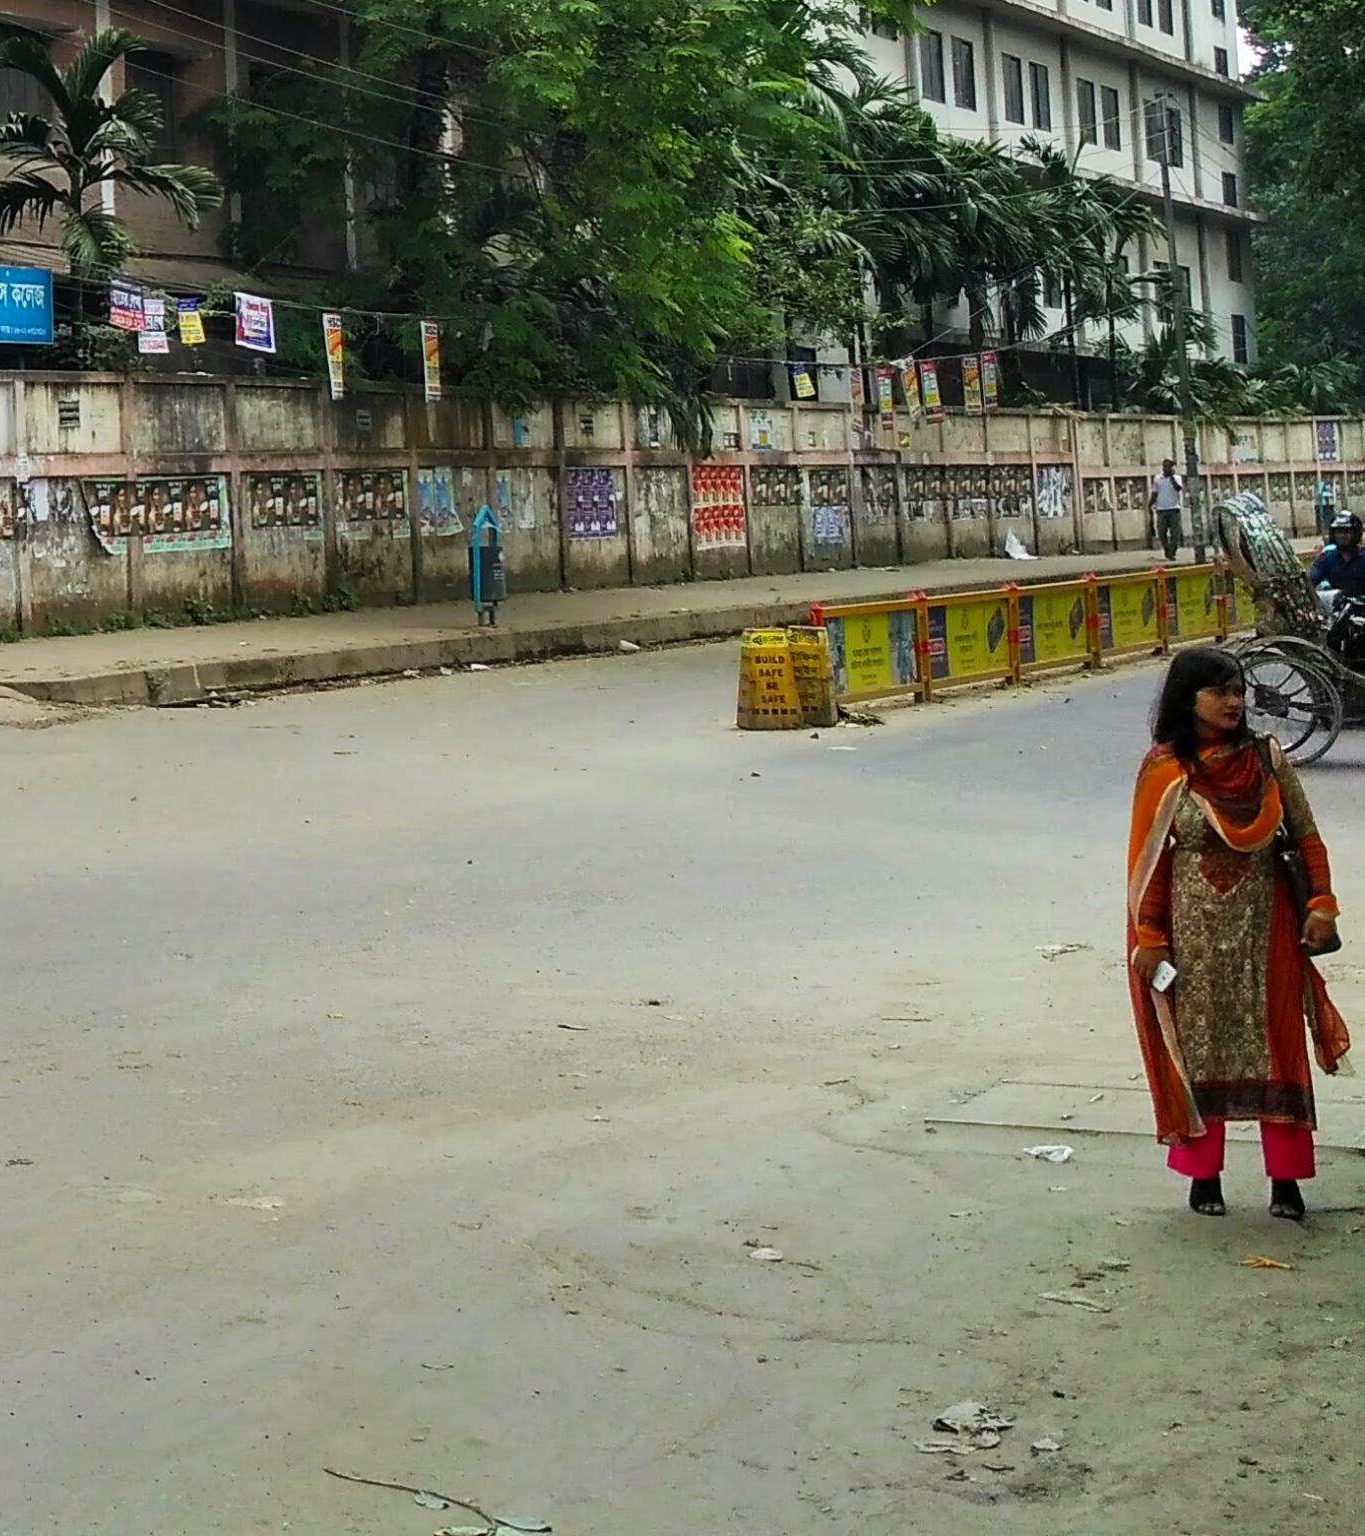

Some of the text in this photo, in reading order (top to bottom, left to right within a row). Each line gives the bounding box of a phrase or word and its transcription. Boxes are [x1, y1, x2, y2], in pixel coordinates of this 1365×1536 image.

[10, 282, 45, 310] কলেজ
[754, 655, 785, 665] BUILD
[758, 668, 784, 678] SAFE
[765, 681, 780, 691] BE
[760, 694, 787, 704] SAFE
